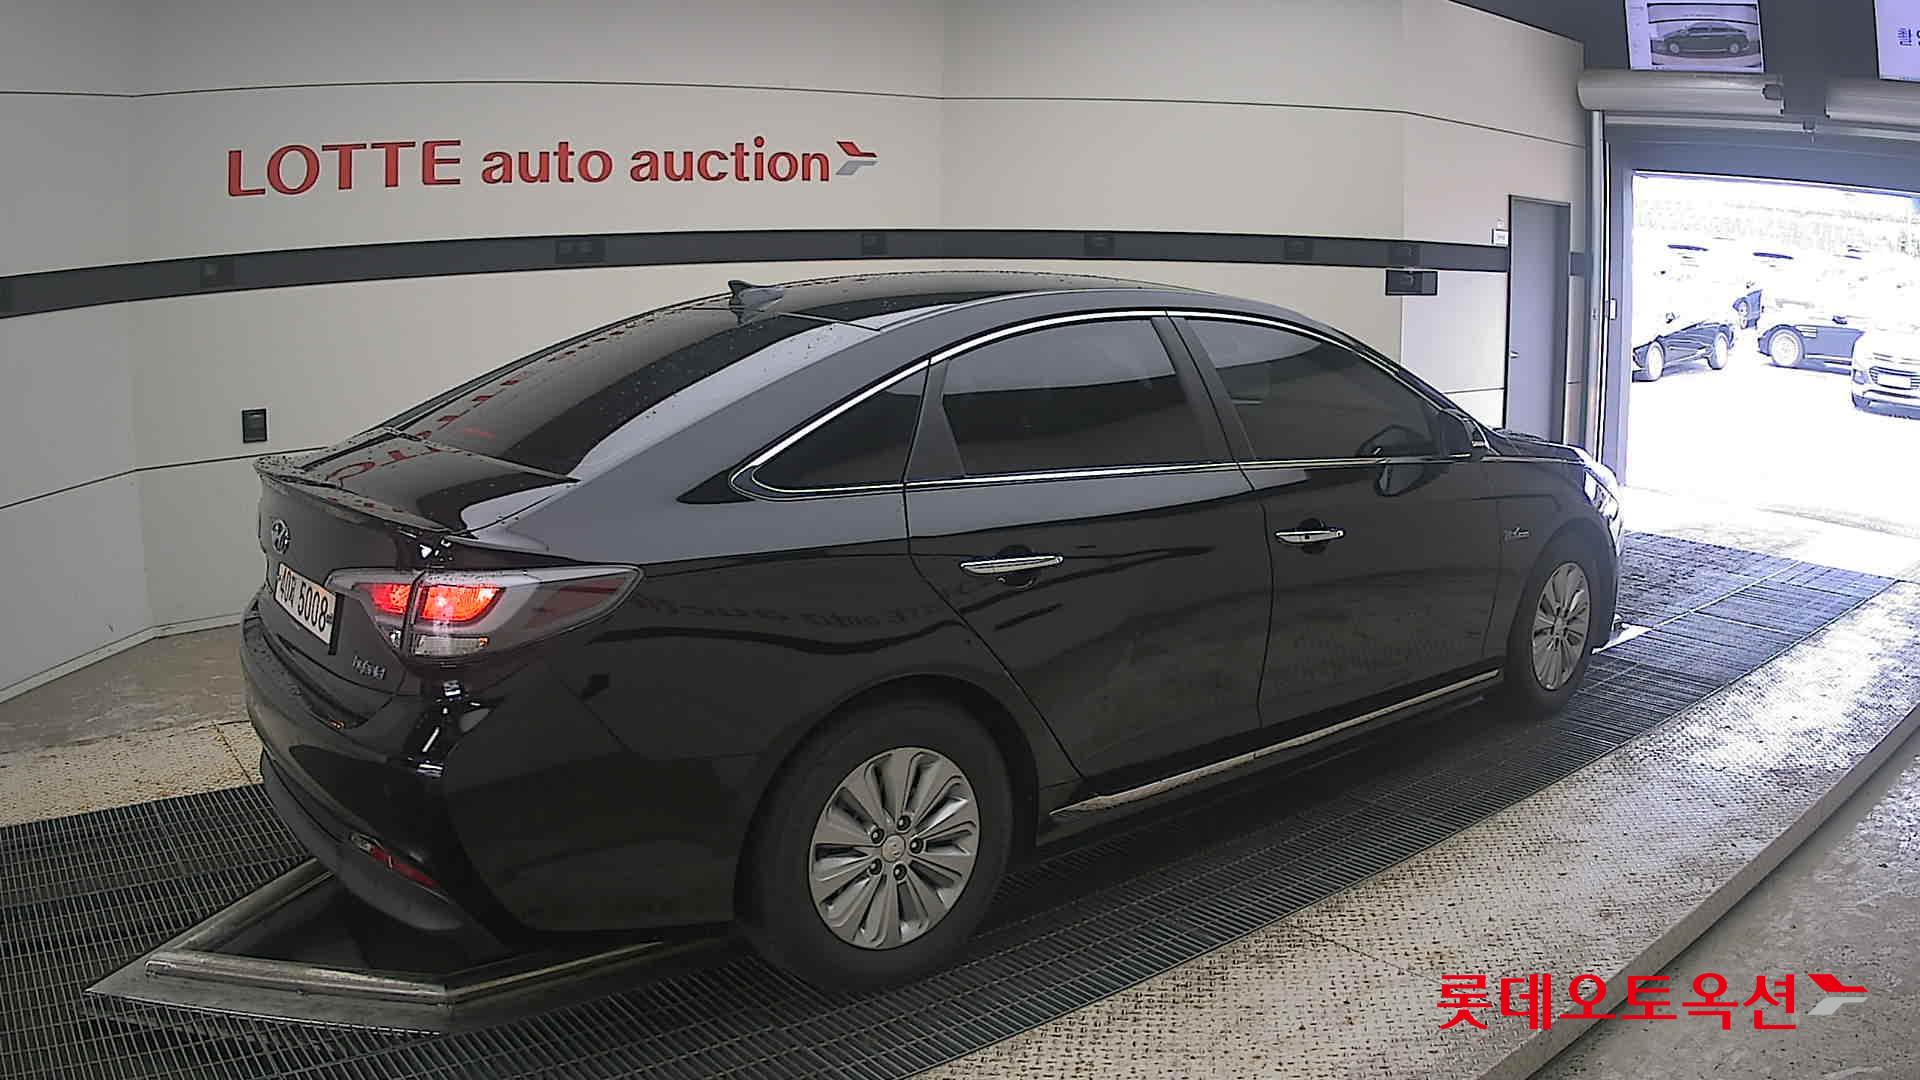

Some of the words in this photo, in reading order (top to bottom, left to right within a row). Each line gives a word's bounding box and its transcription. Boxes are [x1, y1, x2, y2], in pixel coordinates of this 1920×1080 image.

[228, 140, 461, 197] LOTTE
[480, 141, 613, 184] auto
[629, 135, 830, 182] auction
[298, 581, 328, 632] 5008
